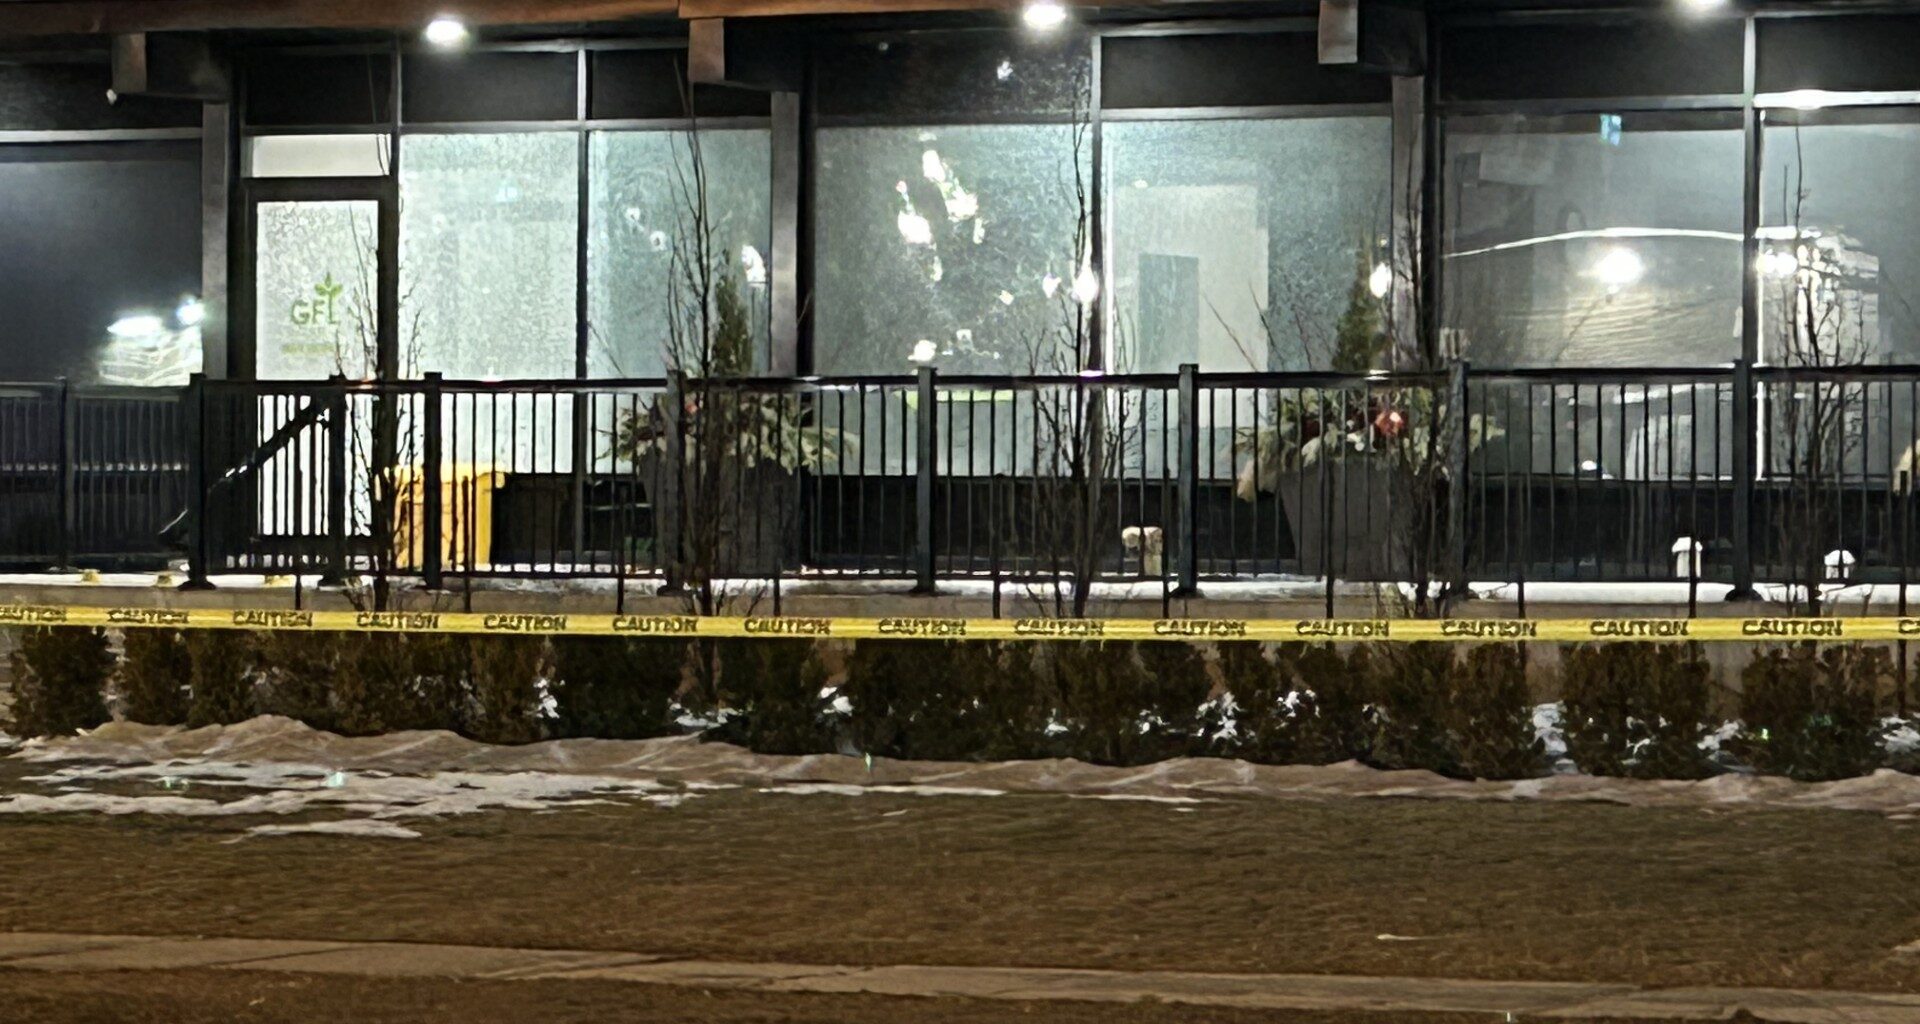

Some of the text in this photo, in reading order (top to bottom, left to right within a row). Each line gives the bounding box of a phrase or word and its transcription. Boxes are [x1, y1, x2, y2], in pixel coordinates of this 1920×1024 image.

[291, 291, 340, 325] GFL
[0, 606, 67, 622] AUTION
[233, 611, 313, 627] CAUTION
[356, 612, 439, 629] CAUTION
[484, 614, 567, 631] CAUTION
[612, 616, 698, 632] CAUTION
[744, 618, 832, 634] CAUTION
[878, 618, 967, 635] CAUTION
[1014, 619, 1105, 635] CAUTION
[1153, 619, 1247, 636] CAUTION
[1295, 620, 1390, 636] CAUTION
[1441, 620, 1537, 637] CAUTION
[1590, 620, 1689, 636] CAUTION
[1742, 620, 1843, 636] CAUTION
